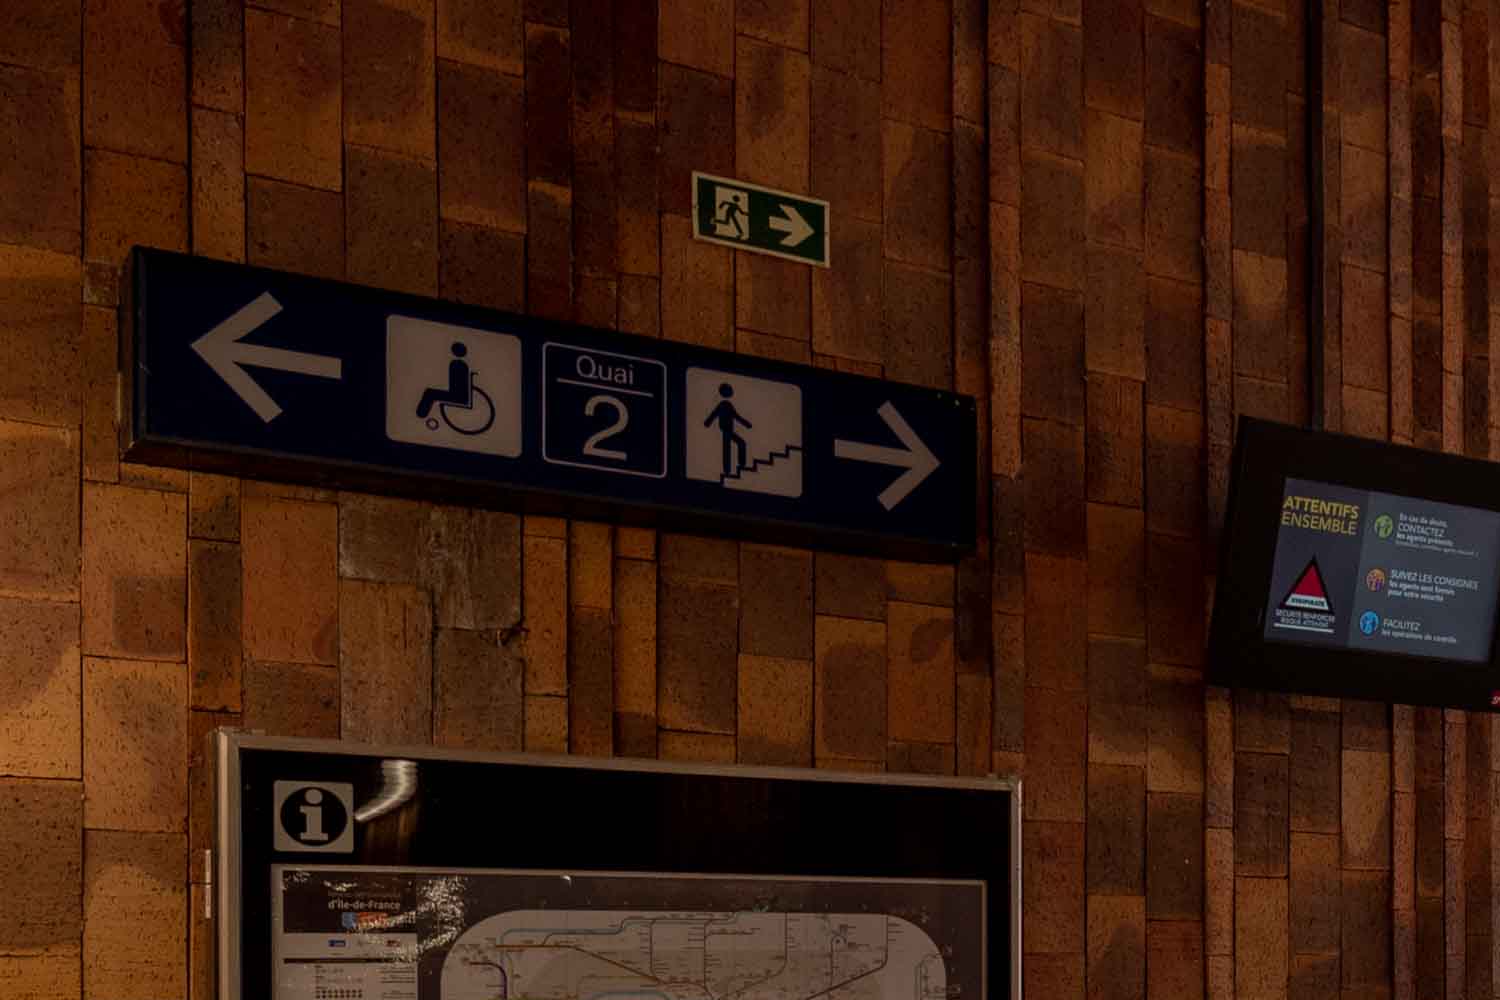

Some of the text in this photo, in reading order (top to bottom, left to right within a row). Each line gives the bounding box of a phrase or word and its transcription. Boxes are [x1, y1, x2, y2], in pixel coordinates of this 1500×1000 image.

[575, 354, 635, 385] Quai
[582, 395, 629, 461] 2
[1282, 496, 1360, 519] ATTENTIFS
[1281, 511, 1357, 536] ENSEMBLE
